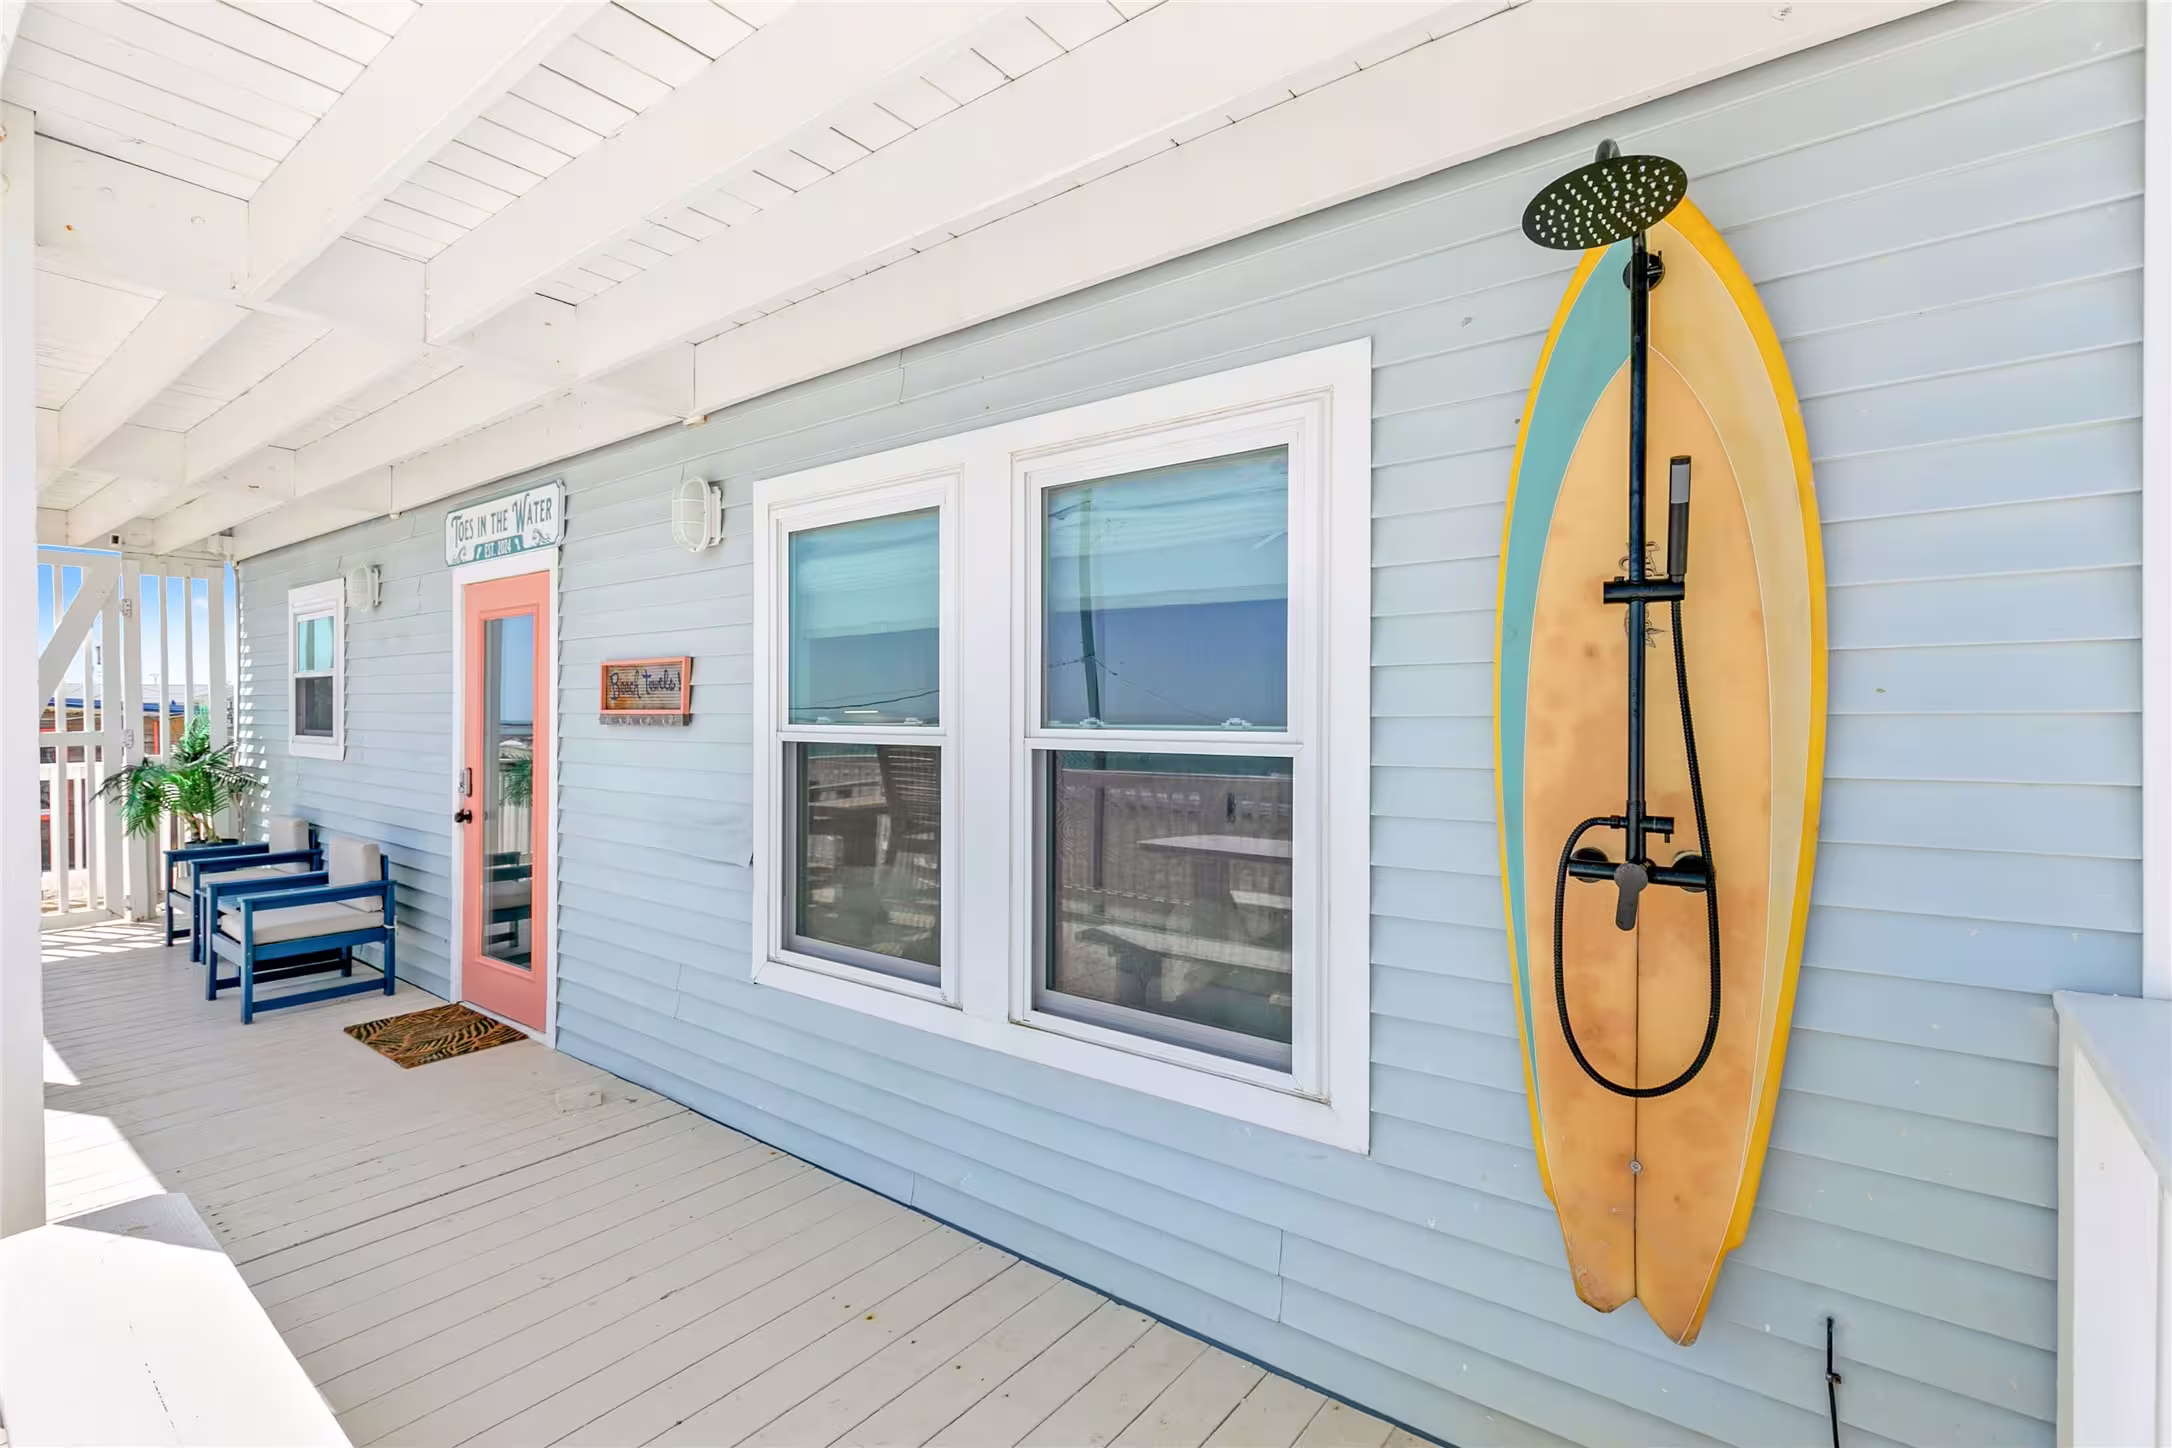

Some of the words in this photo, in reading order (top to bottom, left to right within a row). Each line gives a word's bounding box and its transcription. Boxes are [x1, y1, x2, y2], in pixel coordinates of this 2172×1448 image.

[451, 513, 473, 548] TOES
[478, 515, 487, 538] IN
[490, 509, 508, 535] THE
[512, 493, 552, 534] WATER
